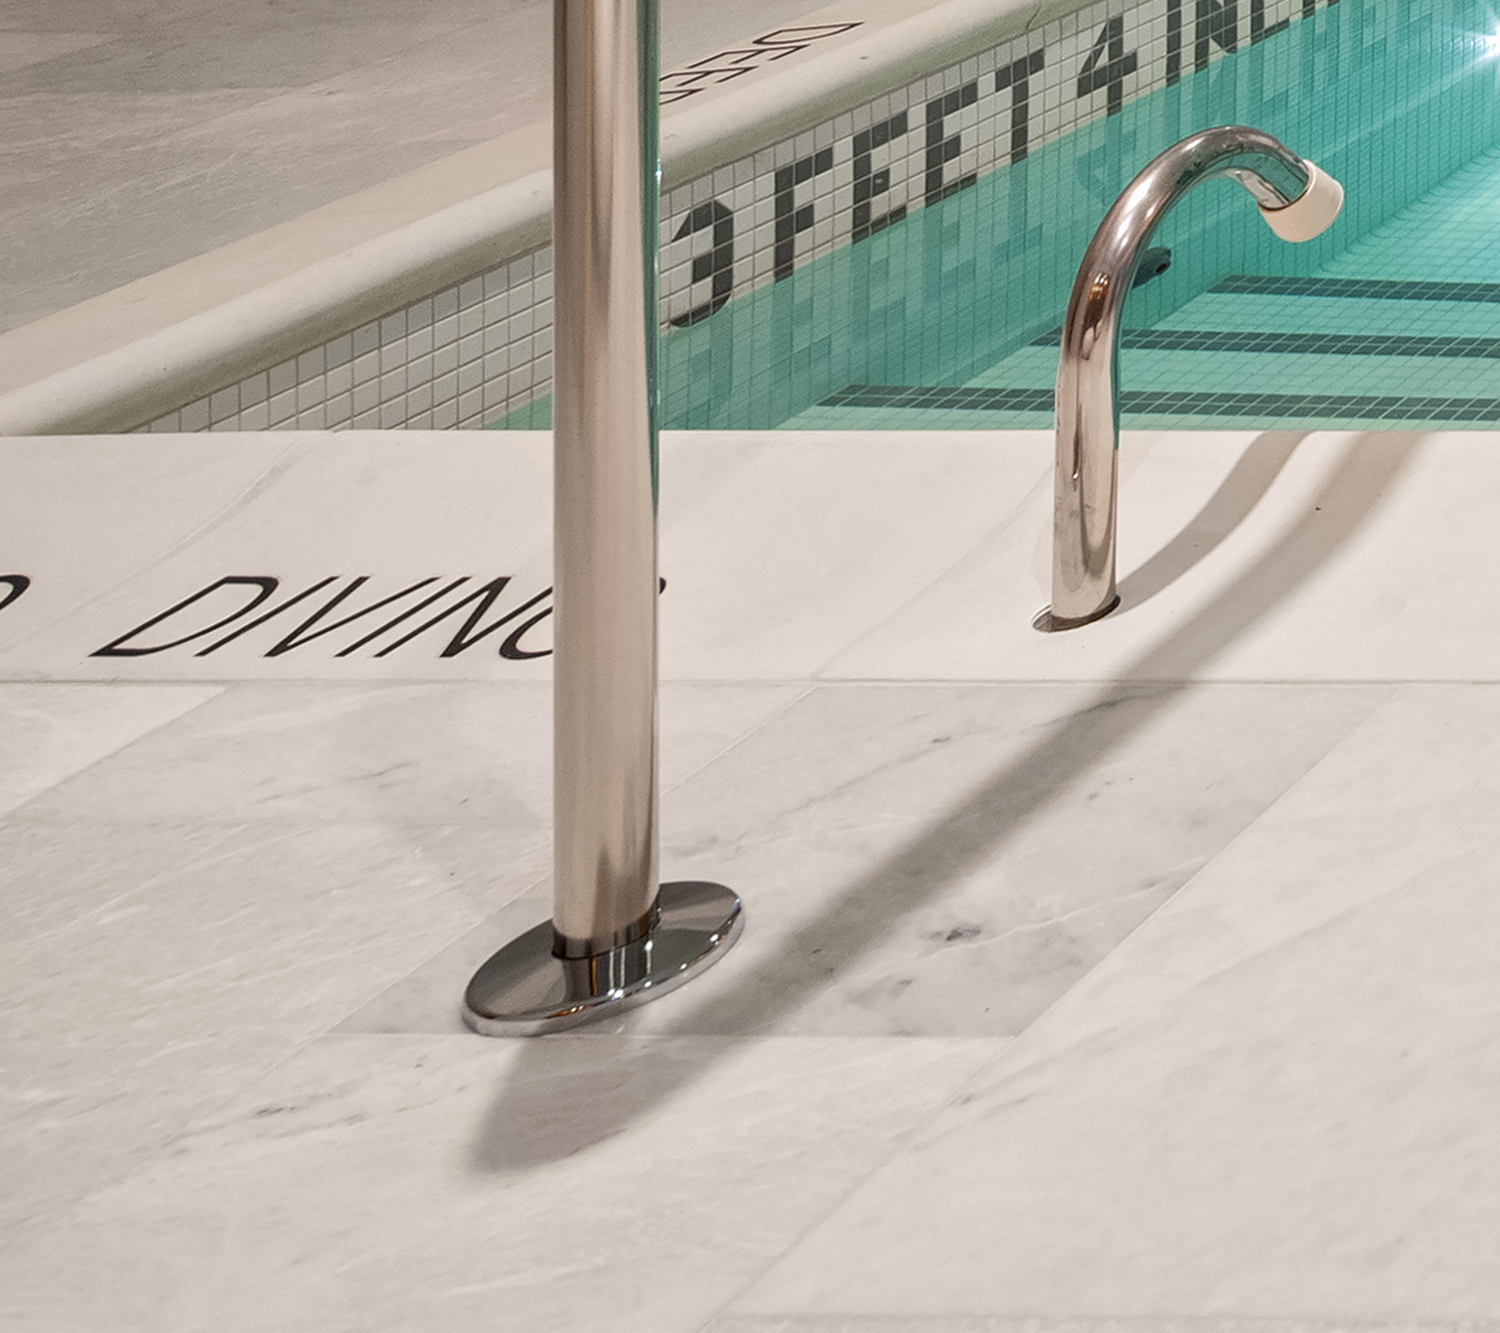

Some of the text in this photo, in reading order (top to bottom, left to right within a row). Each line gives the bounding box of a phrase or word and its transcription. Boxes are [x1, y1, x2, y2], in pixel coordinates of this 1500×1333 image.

[671, 199, 734, 329] 3
[774, 48, 1045, 284] FEET
[1076, 14, 1137, 117] 4
